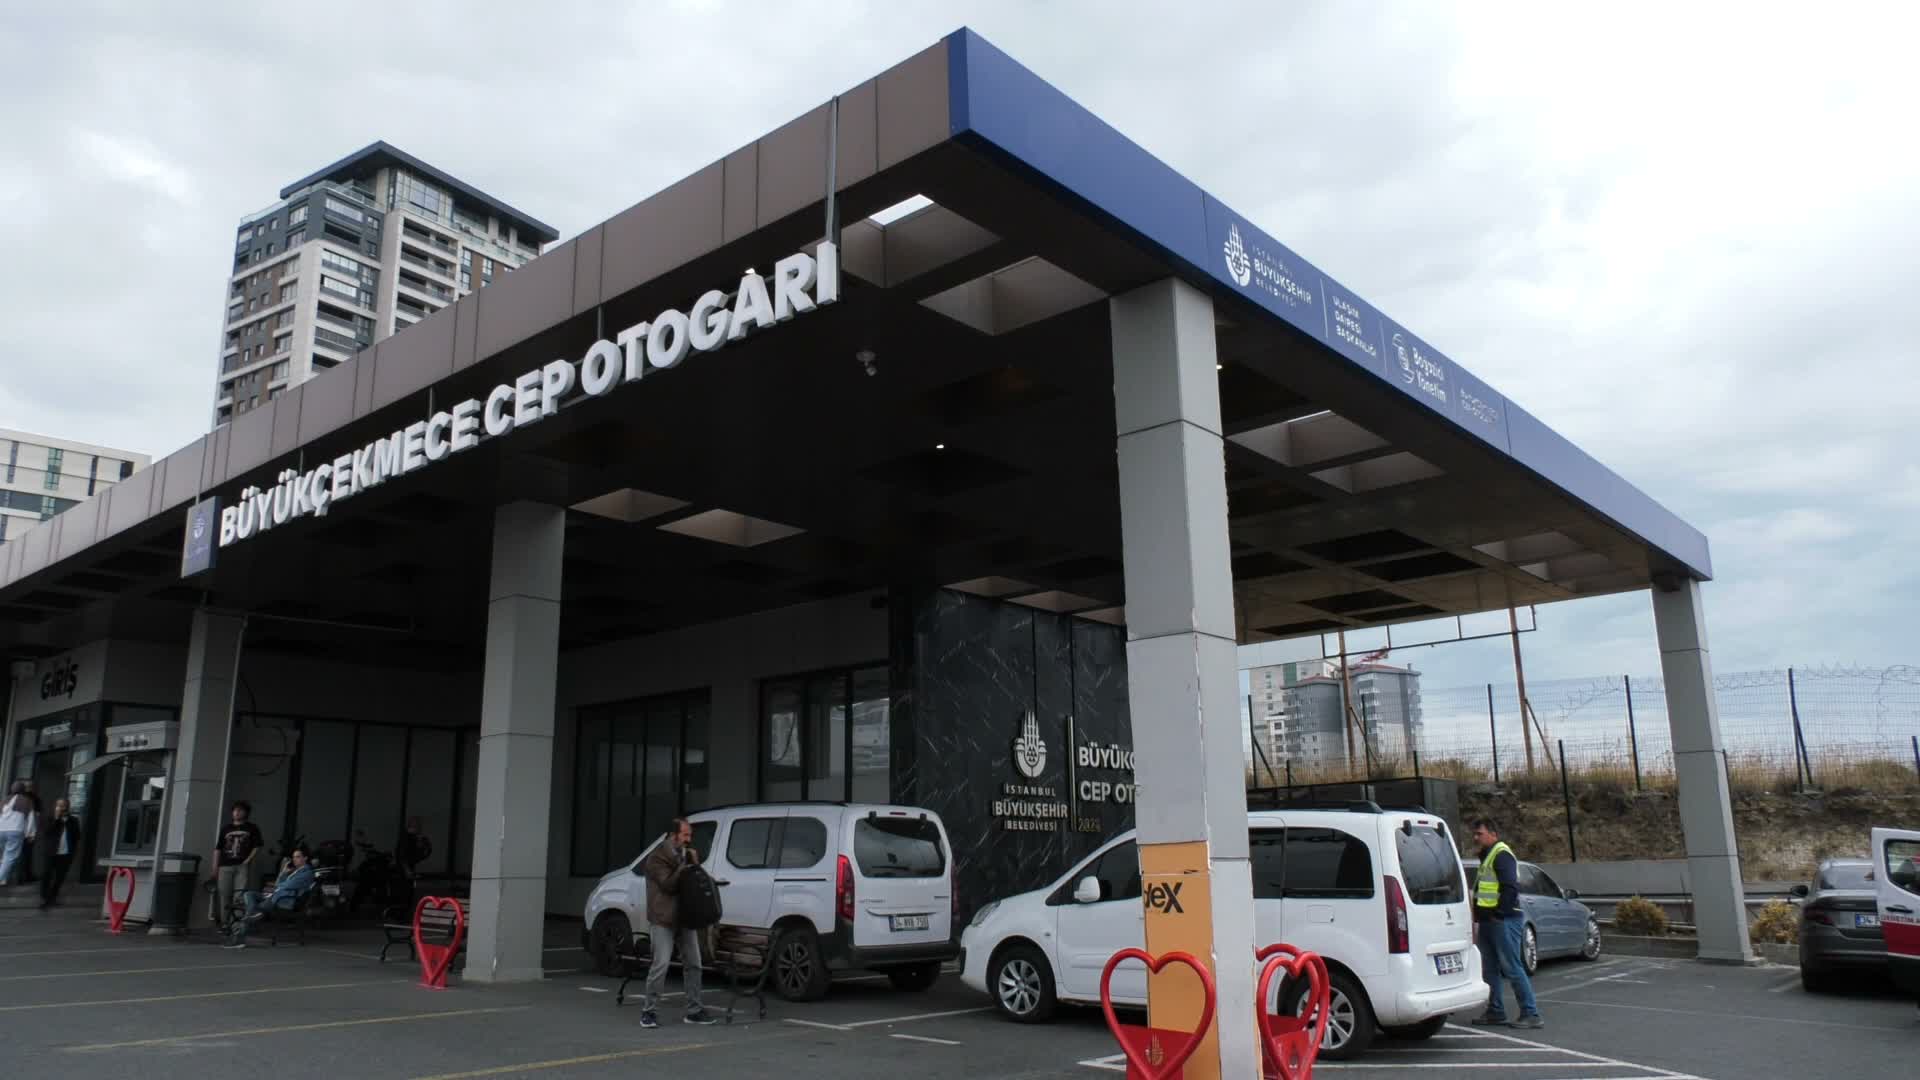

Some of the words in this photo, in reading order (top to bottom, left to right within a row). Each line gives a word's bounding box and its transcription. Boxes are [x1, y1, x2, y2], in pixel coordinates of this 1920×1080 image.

[219, 398, 481, 548] BÜYÜKÇEKMECE
[484, 359, 575, 438] CEP
[581, 240, 838, 396] OTOGARI
[1005, 783, 1056, 797] İSTANBUL
[1080, 780, 1111, 802] CEP
[994, 799, 1068, 819] BÜYÜKŞEHİR
[1006, 819, 1057, 832] BELEDİYESİ
